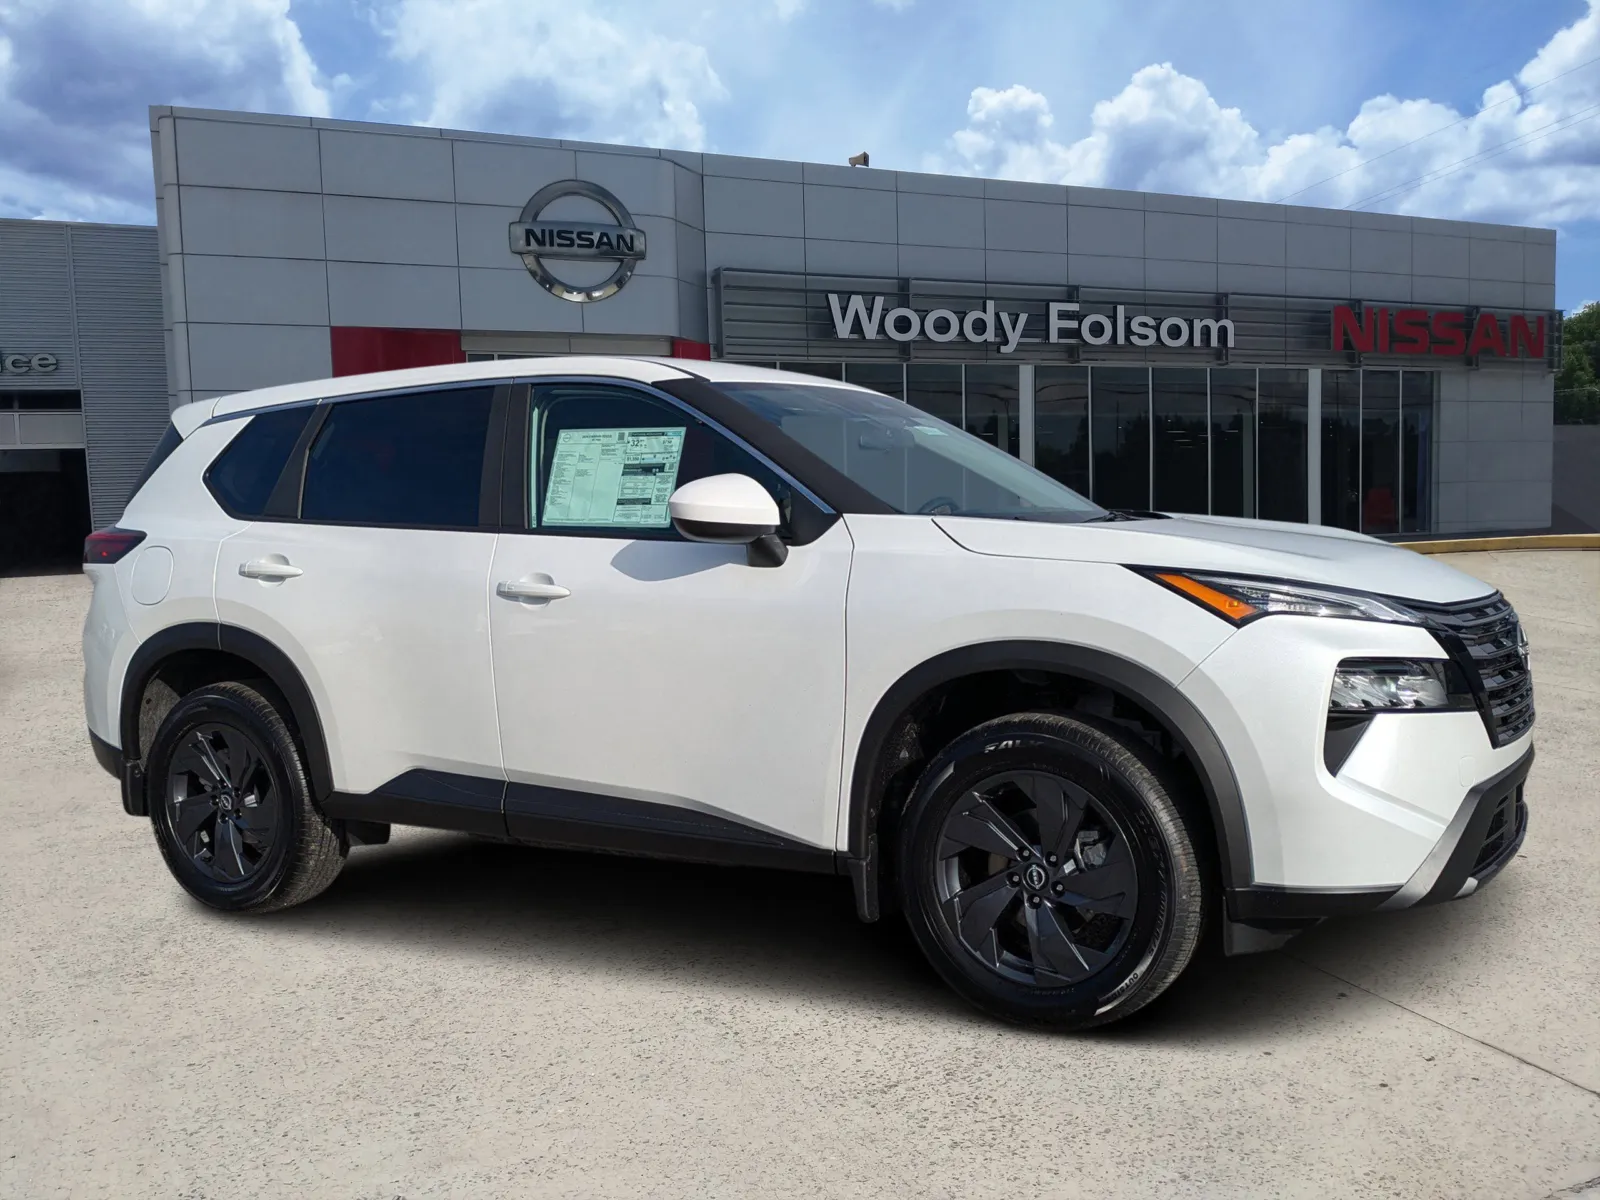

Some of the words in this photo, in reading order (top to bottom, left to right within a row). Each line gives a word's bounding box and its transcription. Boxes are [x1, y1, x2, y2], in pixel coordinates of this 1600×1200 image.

[525, 228, 635, 252] NISSAN
[827, 293, 1028, 354] Woody
[1047, 301, 1235, 349] Folsom
[1332, 304, 1546, 359] NISSAN
[0, 353, 58, 374] ce
